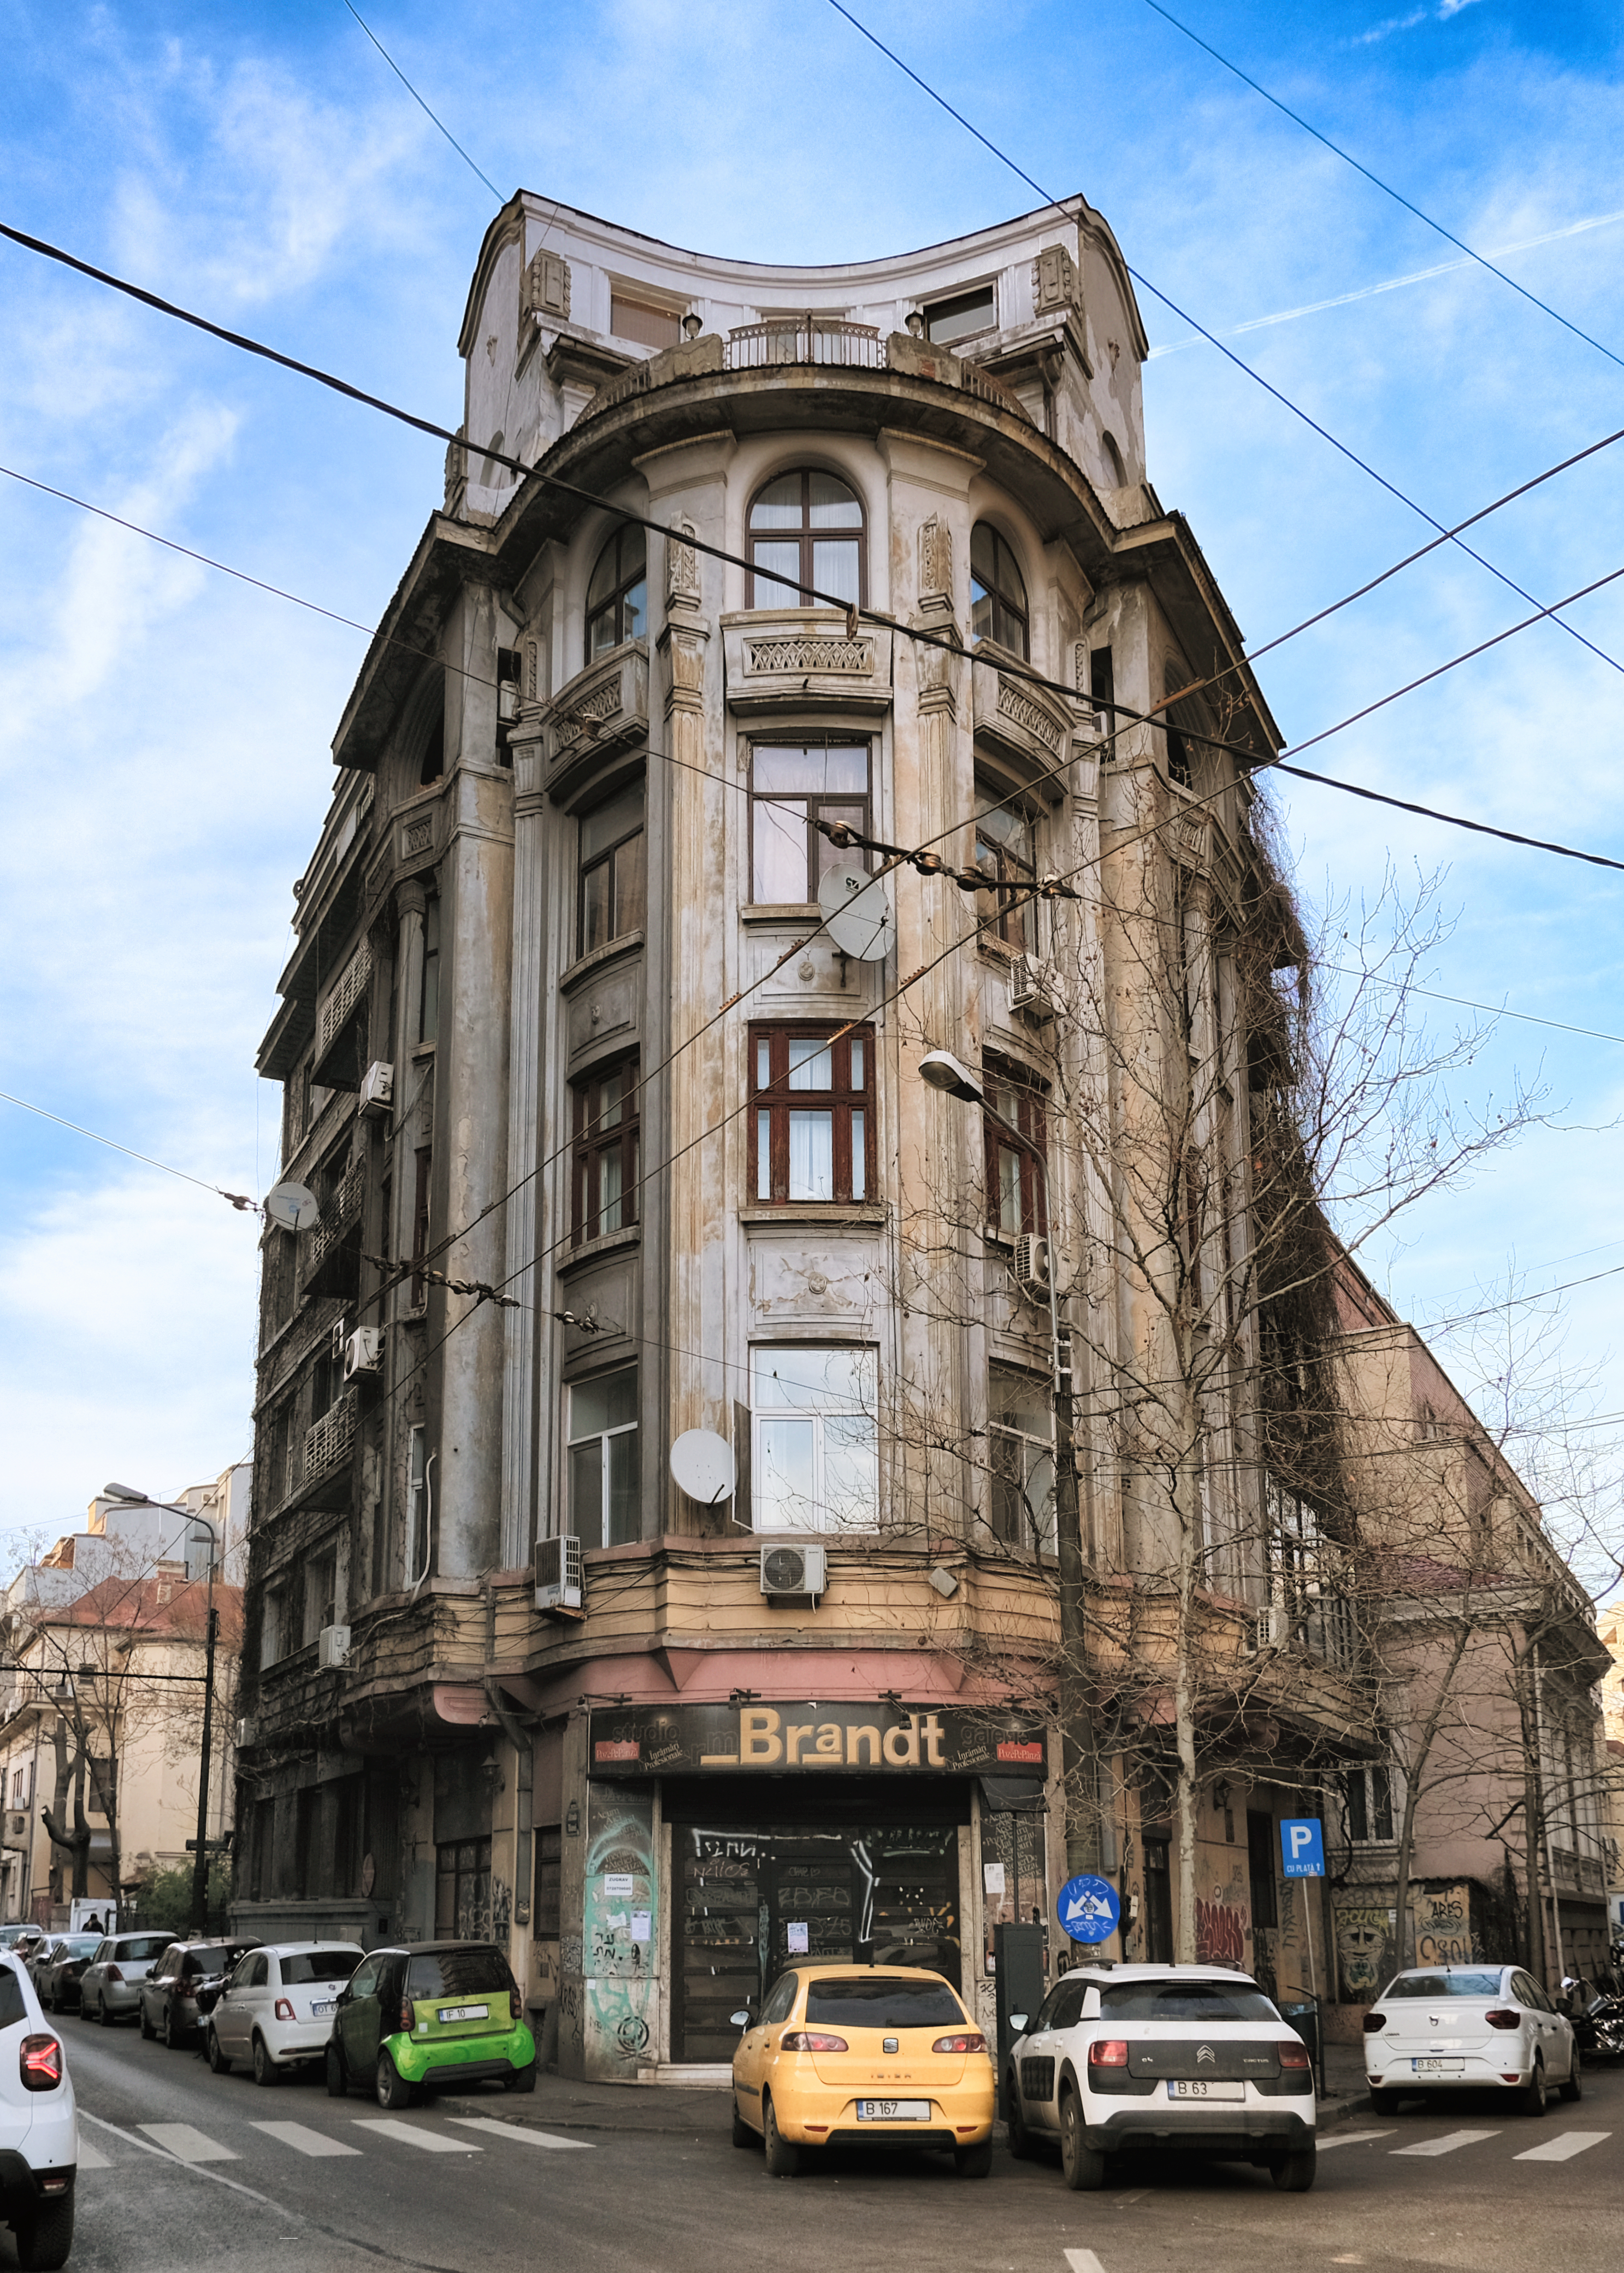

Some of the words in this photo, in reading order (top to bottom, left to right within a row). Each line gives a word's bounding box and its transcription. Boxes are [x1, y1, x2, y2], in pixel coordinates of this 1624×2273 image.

[612, 1719, 681, 1744] studio
[739, 1707, 946, 1768] Brandt
[961, 1726, 1030, 1747] galerie
[645, 1749, 683, 1770] Profesionale
[953, 1751, 990, 1770] Profesionale
[597, 1808, 620, 1821] Acum
[989, 1812, 1013, 1824] Acum
[1001, 1840, 1032, 1856] Caouri
[1290, 1826, 1312, 1858] P
[318, 2005, 328, 2013] OT
[446, 2010, 453, 2019] IF
[457, 2009, 465, 2018] 10
[1418, 2060, 1424, 2069] B
[1427, 2059, 1443, 2068] 604
[1178, 2081, 1187, 2094] B
[1192, 2082, 1207, 2095] 63
[866, 2103, 875, 2115] B
[879, 2103, 897, 2115] 167
